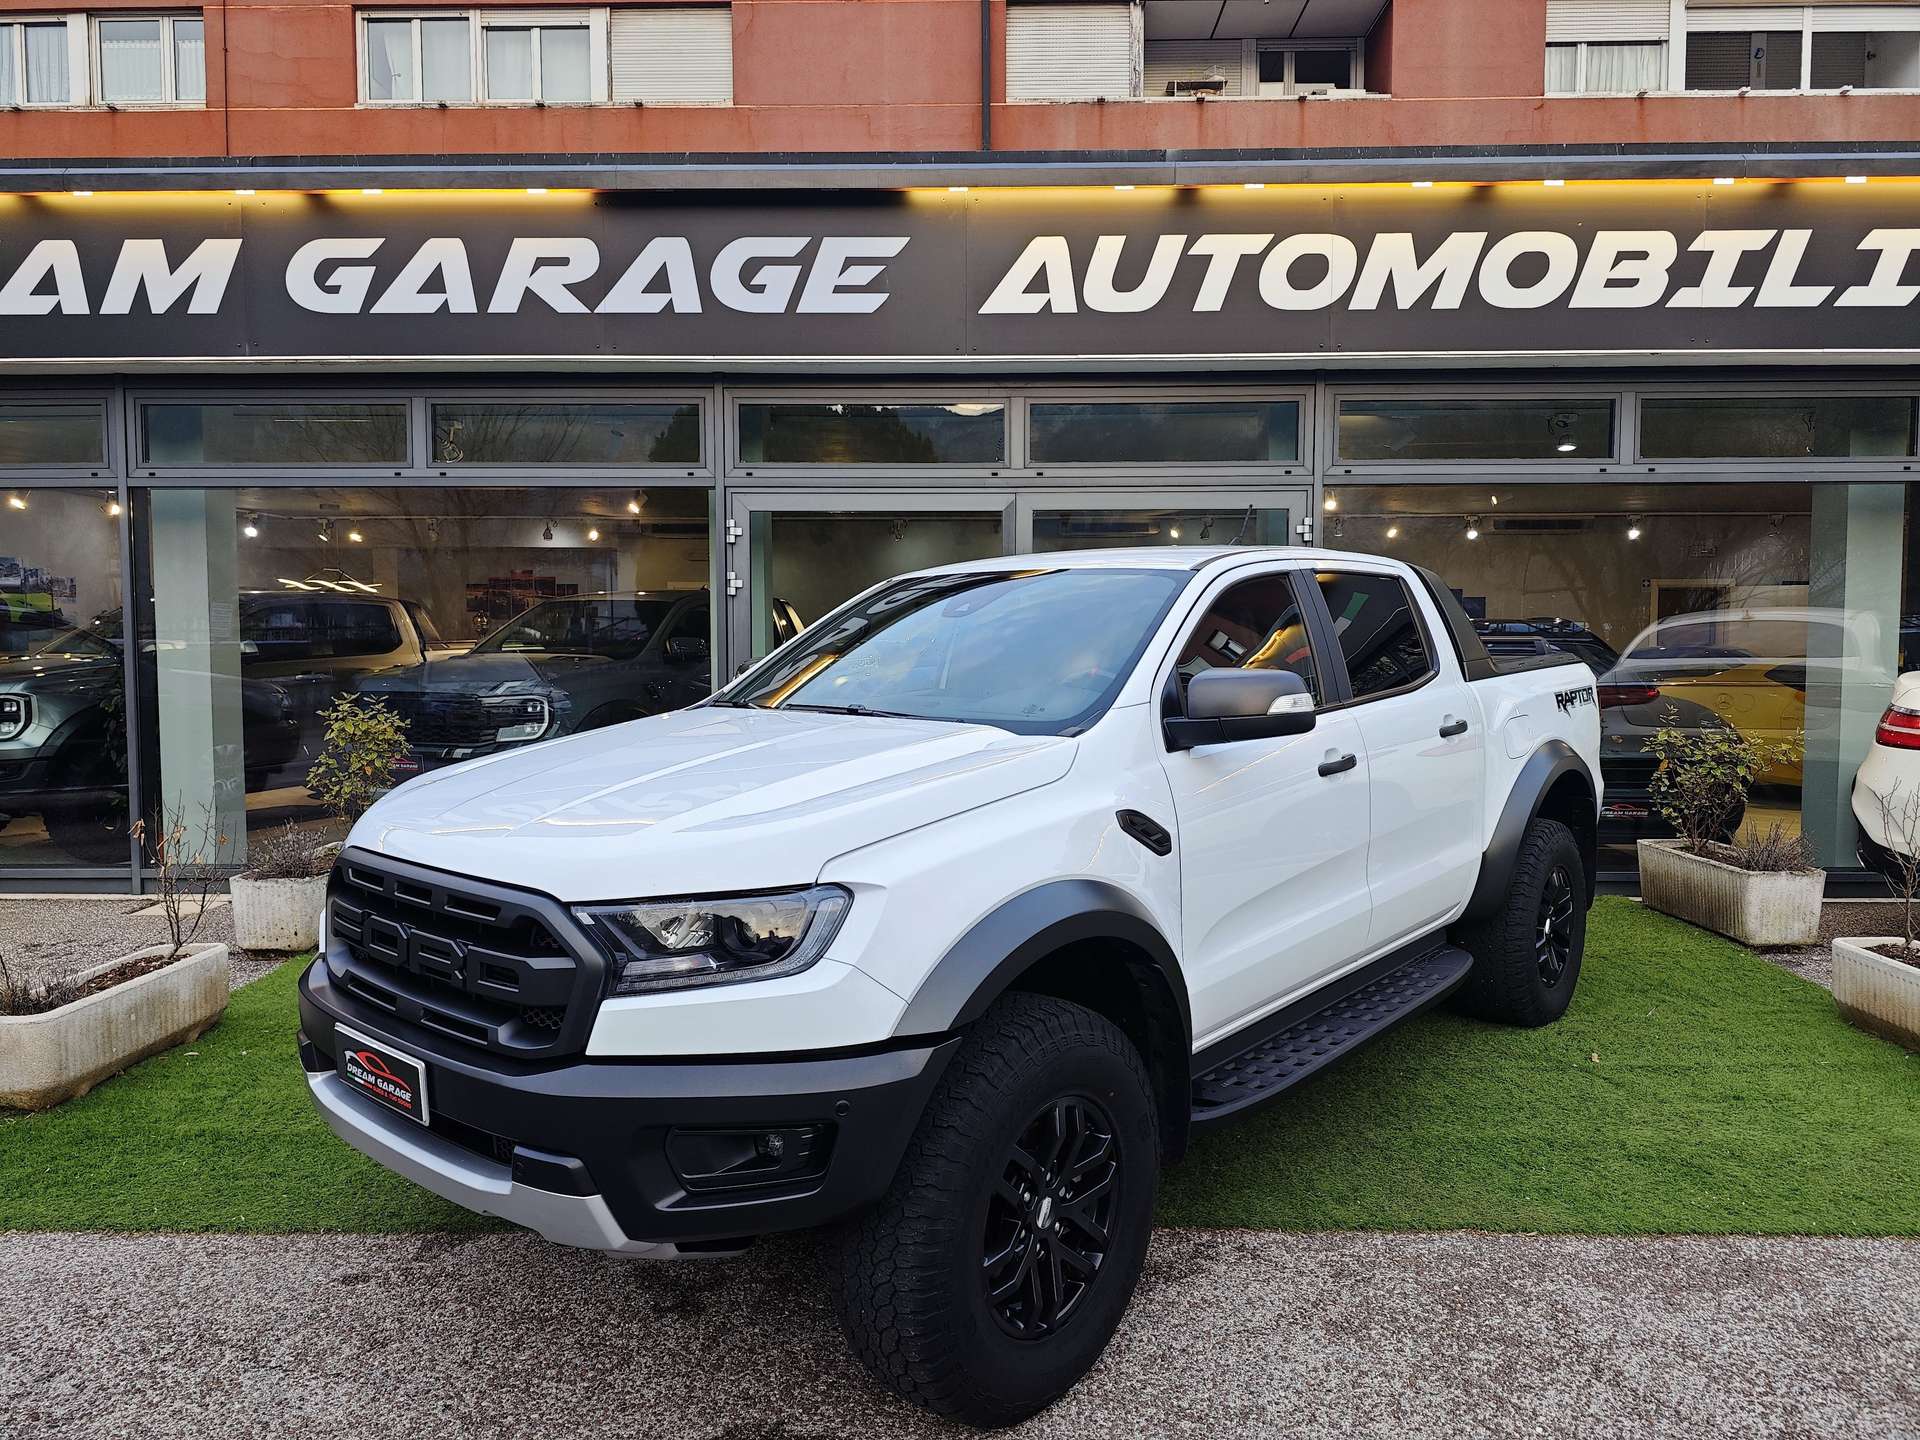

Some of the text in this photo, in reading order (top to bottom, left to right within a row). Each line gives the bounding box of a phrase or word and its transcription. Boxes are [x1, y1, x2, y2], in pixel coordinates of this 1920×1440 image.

[0, 229, 1920, 315] AM GARAGE AUTOMOBILI
[1554, 686, 1597, 718] RAPTOR
[332, 896, 536, 1000] FORD
[346, 1062, 376, 1084] DREAM
[376, 1078, 412, 1103] GARAGE
